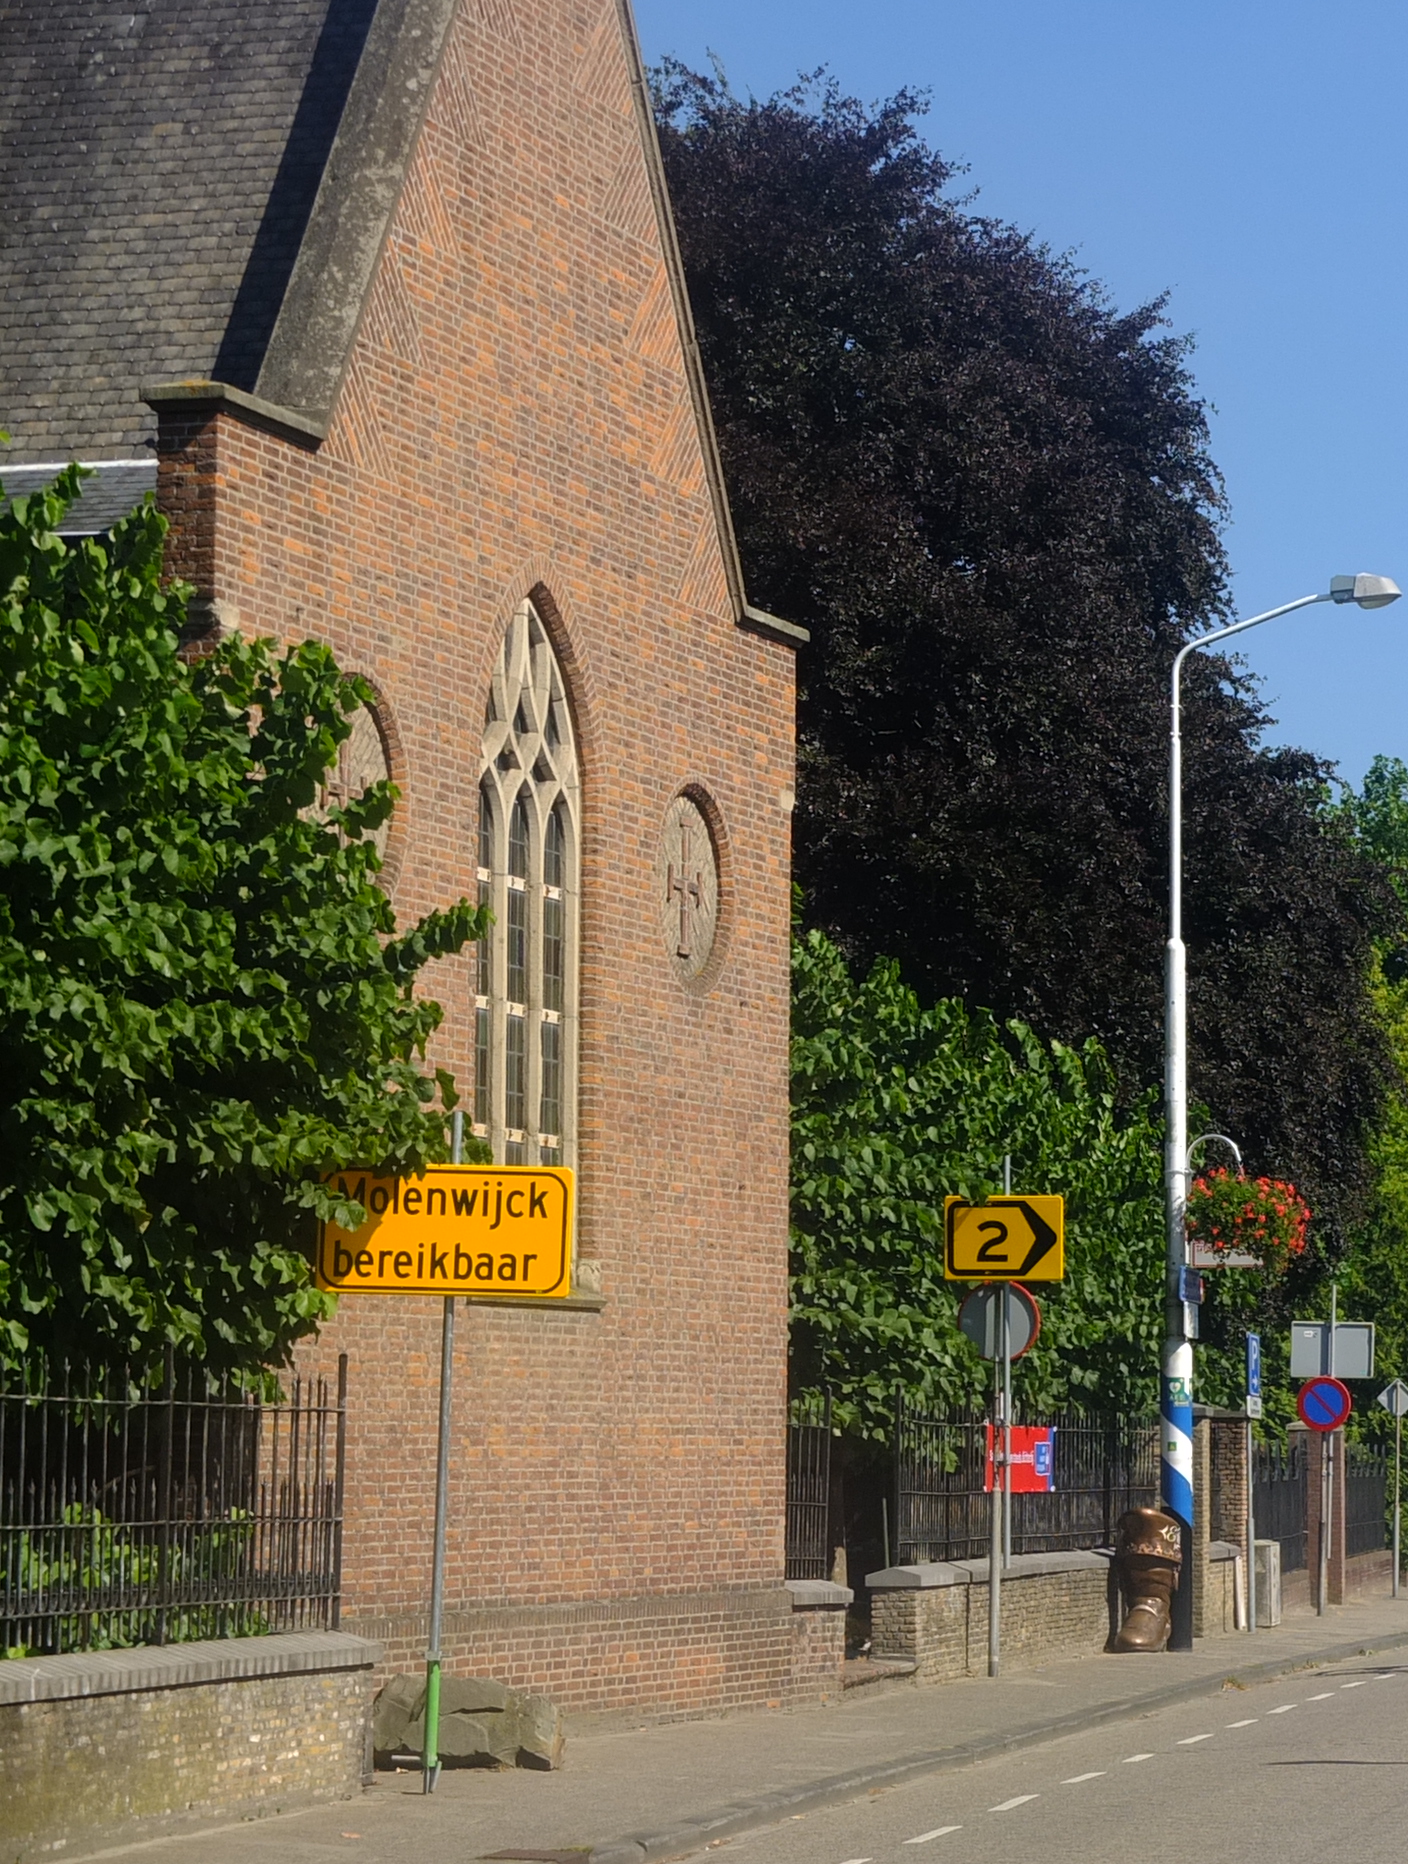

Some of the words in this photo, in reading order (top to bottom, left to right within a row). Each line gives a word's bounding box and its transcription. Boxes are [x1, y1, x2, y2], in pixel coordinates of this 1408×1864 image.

[337, 1177, 548, 1230] Molenwijck
[333, 1240, 538, 1282] bereikbaar
[976, 1220, 1008, 1262] 2
[1251, 1340, 1258, 1370] P
